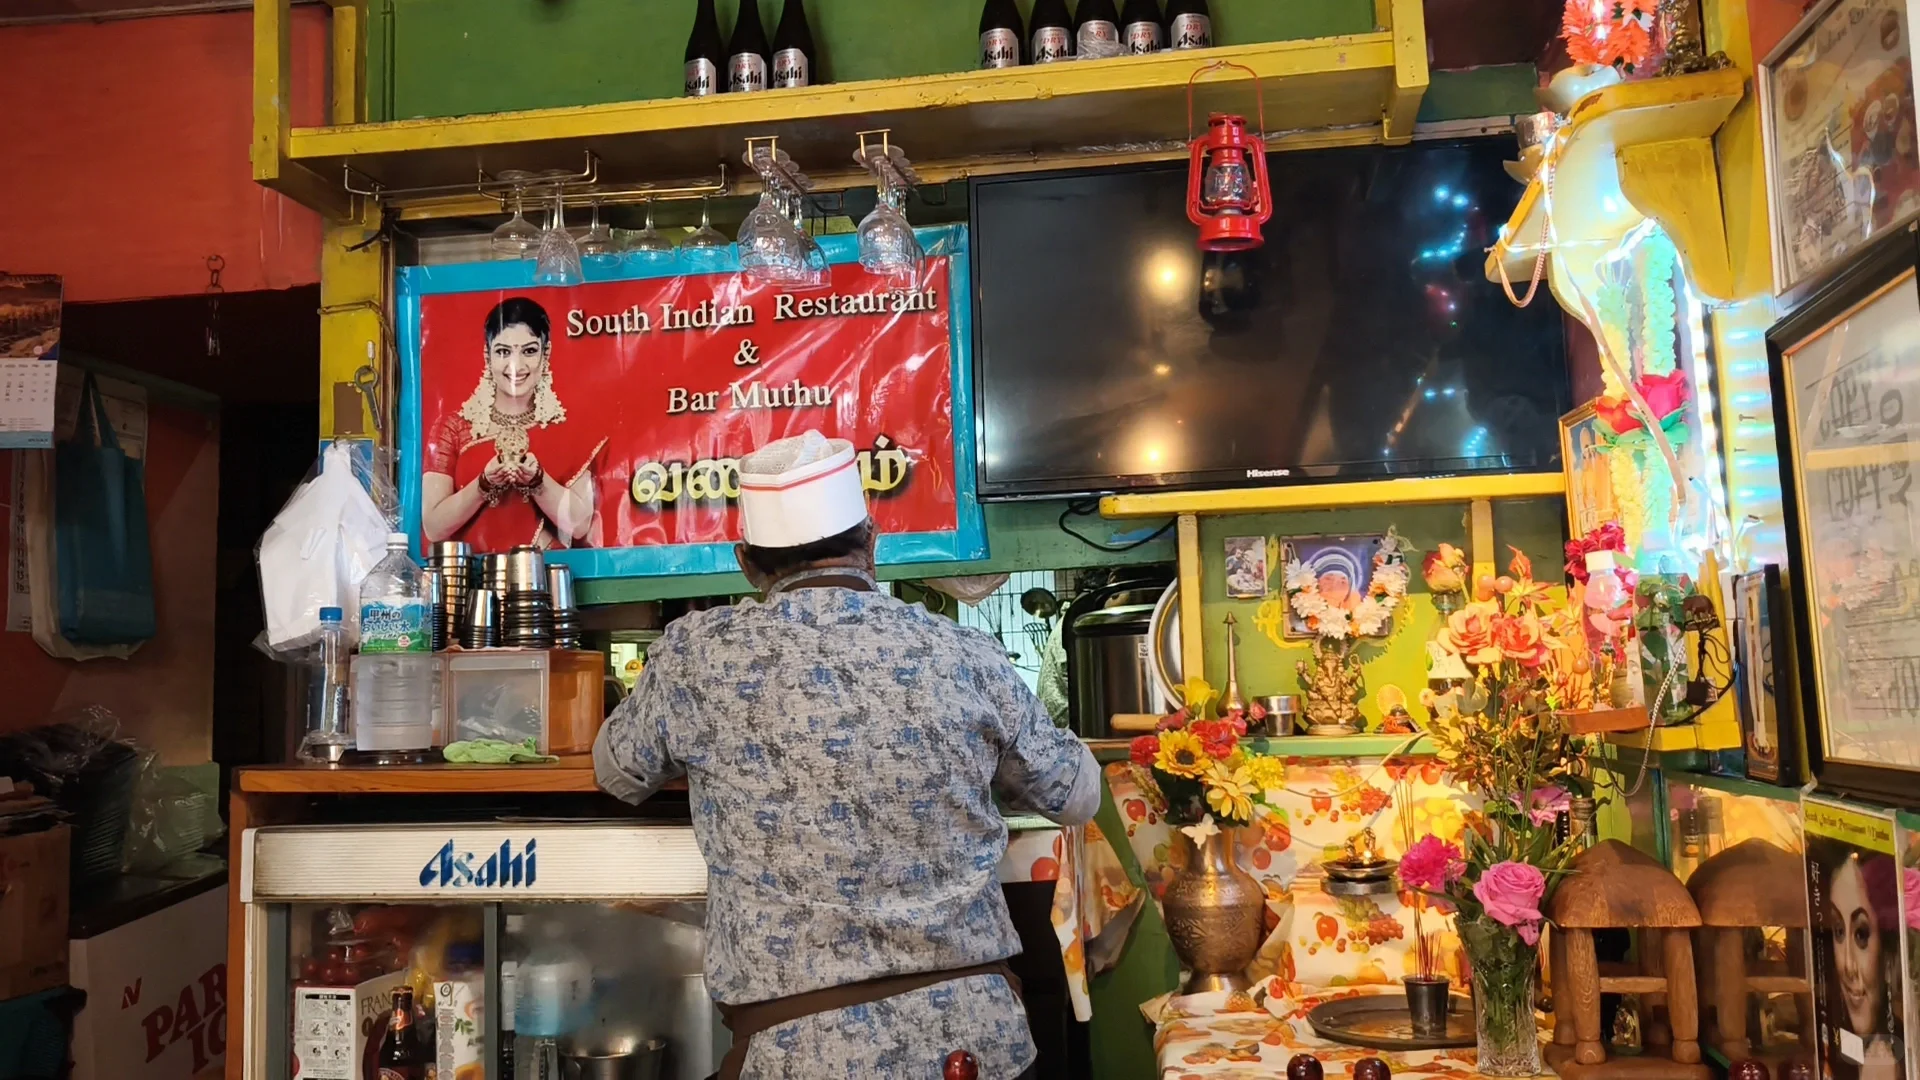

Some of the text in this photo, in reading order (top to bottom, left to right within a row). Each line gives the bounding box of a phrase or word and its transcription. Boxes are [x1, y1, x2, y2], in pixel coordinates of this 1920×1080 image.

[982, 46, 1013, 64] Asahi
[687, 75, 710, 91] sahi
[730, 71, 762, 88] Asahi
[566, 286, 938, 337] South Indian Restaurant
[733, 339, 760, 367] &
[666, 379, 832, 414] Bar Muthu
[1246, 469, 1290, 478] Hisense
[370, 608, 402, 621] 甲州の
[362, 620, 410, 633] おいしい水
[419, 838, 536, 888] Asahi
